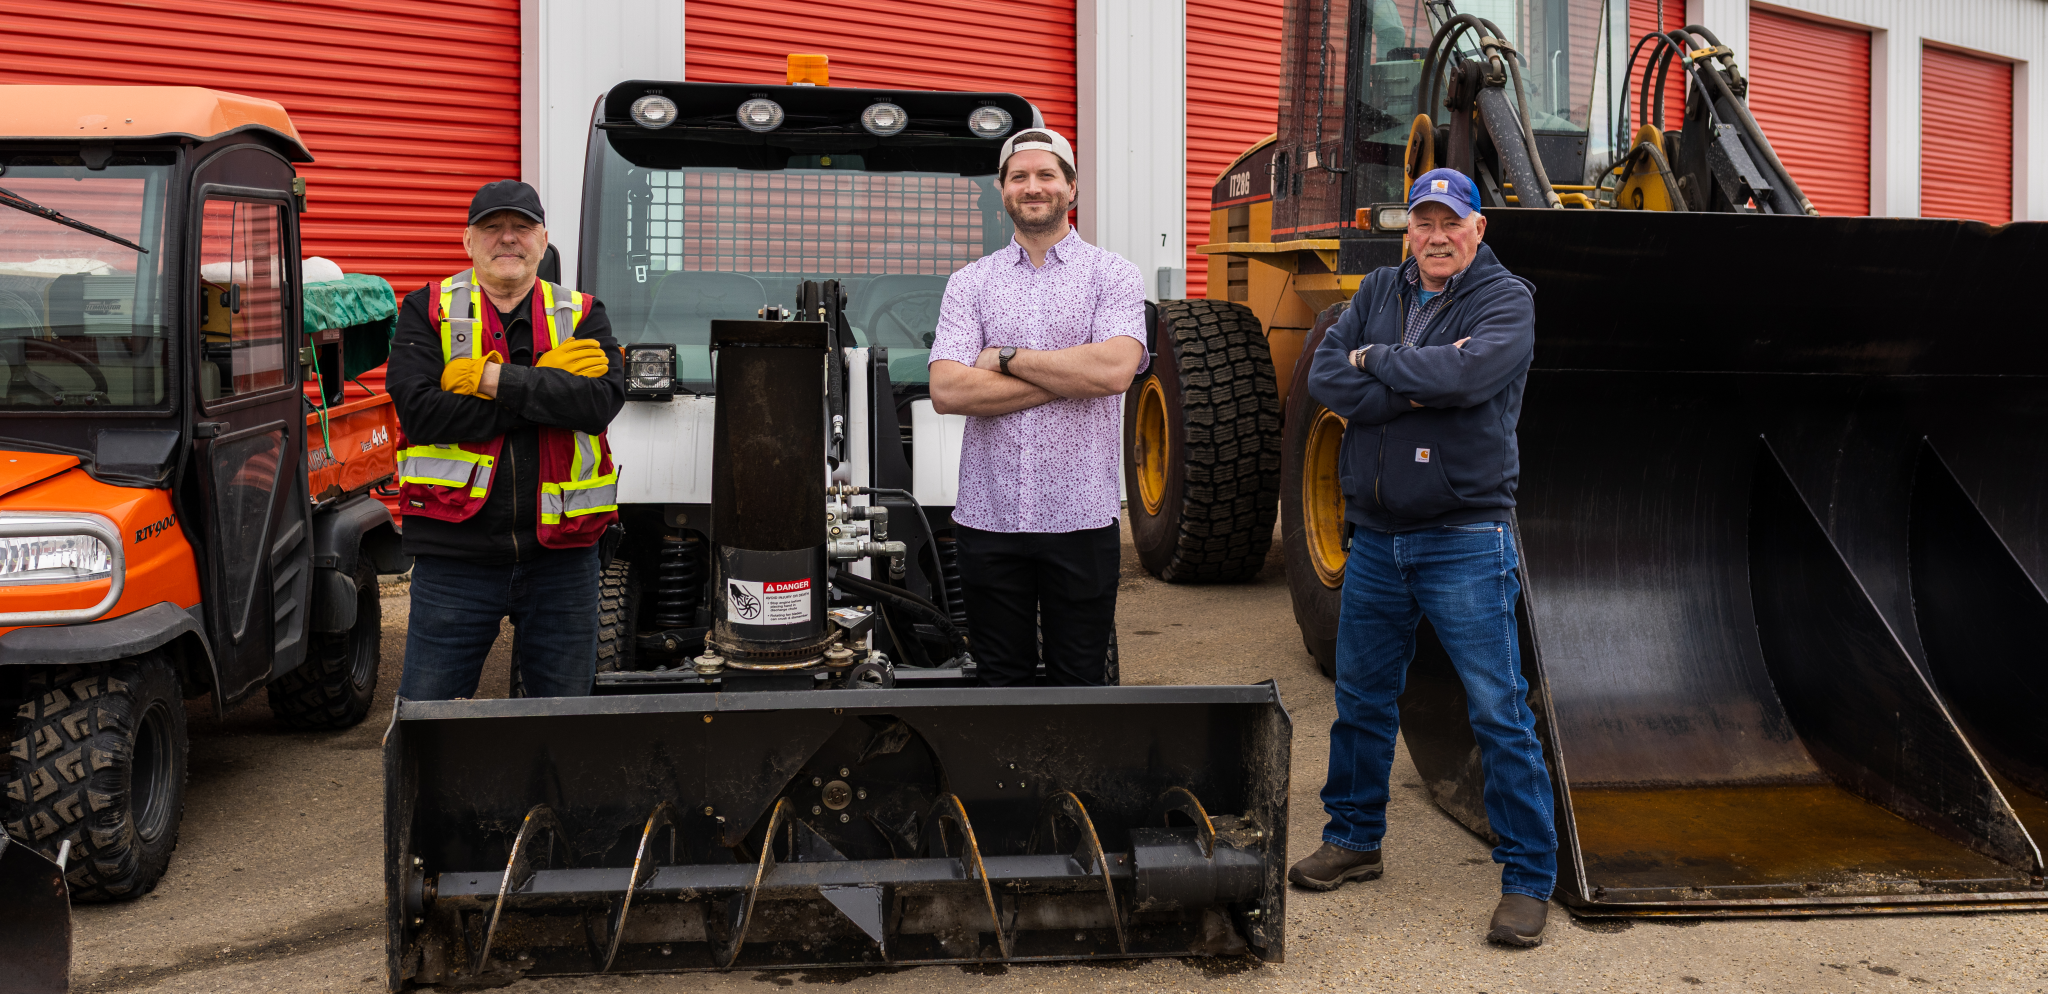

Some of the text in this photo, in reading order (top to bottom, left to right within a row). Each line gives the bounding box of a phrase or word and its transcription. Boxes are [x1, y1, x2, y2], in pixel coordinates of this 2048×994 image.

[1229, 171, 1250, 198] IT28G
[1161, 233, 1167, 247] 7
[372, 425, 389, 447] 4x4
[307, 446, 338, 473] UBOA
[134, 513, 176, 544] RTV900
[777, 581, 809, 591] DANGER
